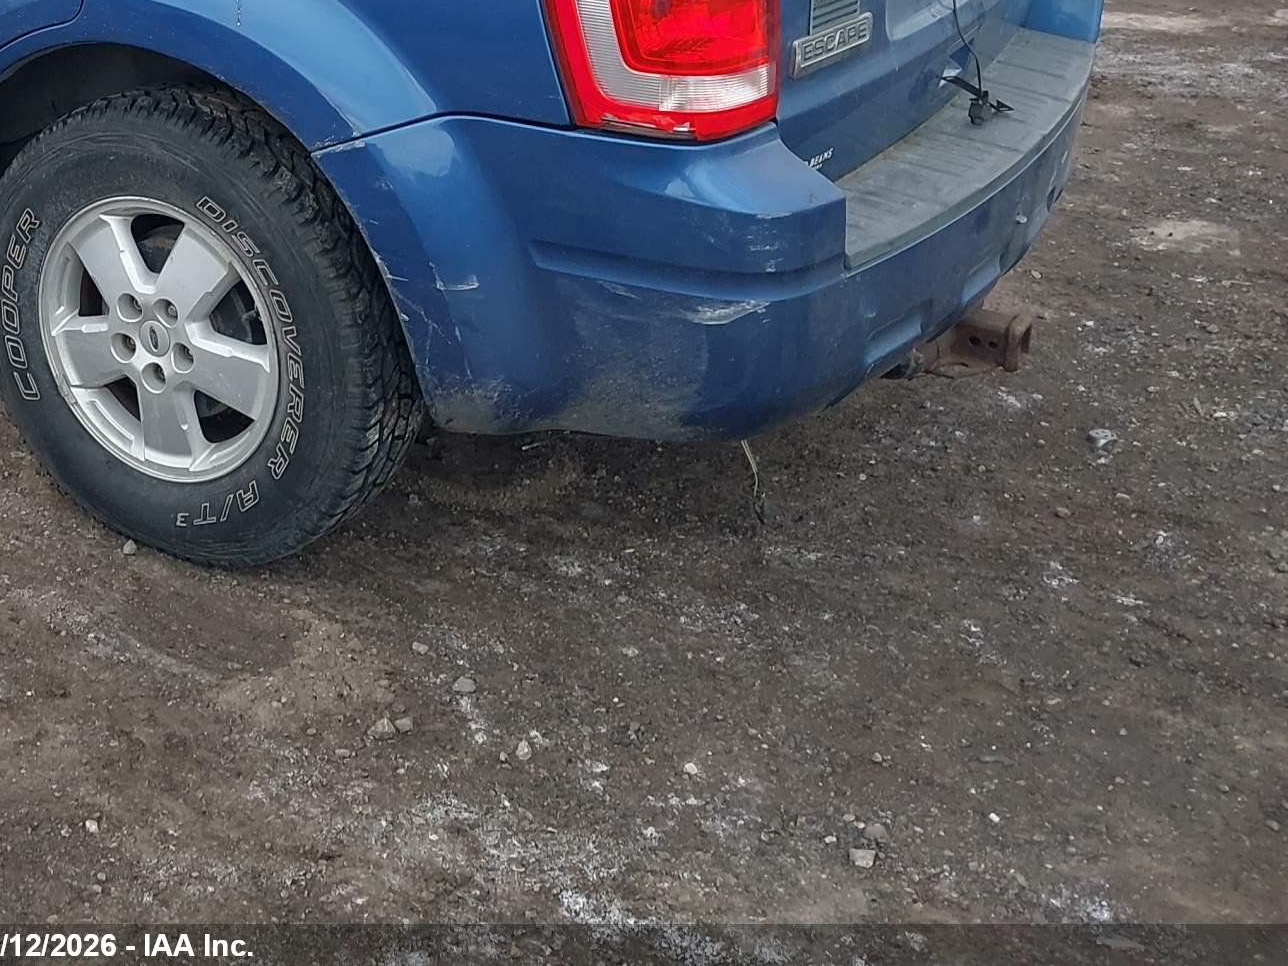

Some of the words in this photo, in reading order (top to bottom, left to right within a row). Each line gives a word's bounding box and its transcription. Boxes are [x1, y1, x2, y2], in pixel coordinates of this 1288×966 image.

[802, 18, 869, 62] ESCAPE
[0, 208, 41, 401] COOPER
[196, 195, 306, 481] DISCOVERER
